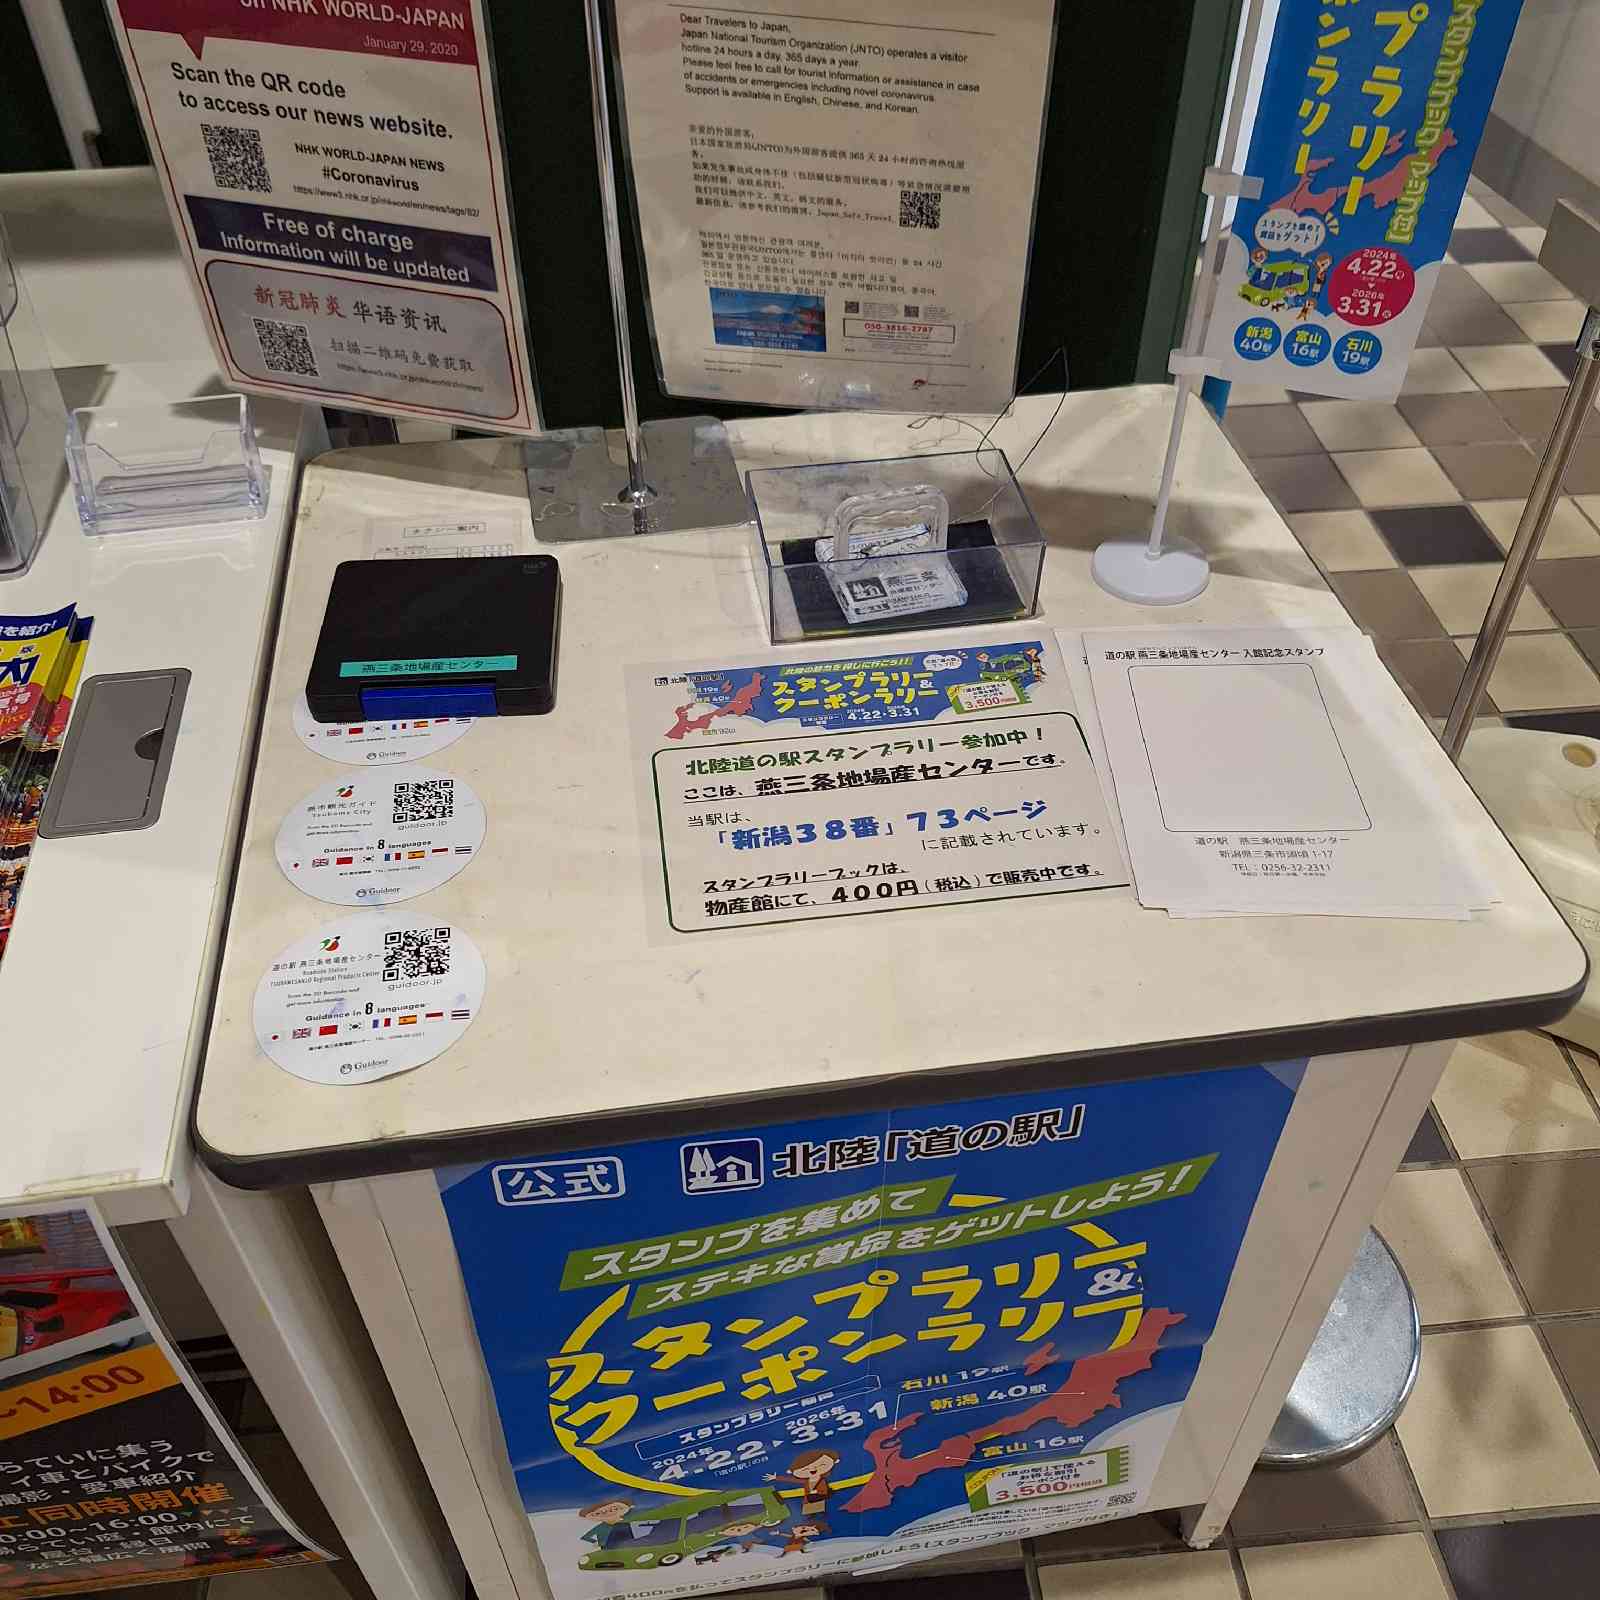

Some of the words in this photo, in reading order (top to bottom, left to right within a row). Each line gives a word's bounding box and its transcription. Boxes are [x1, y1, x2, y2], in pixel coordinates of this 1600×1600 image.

[323, 0, 465, 31] WORLD-JAPAN
[680, 13, 702, 25] Dear
[705, 15, 746, 29] Travelers
[363, 35, 410, 53] January
[431, 43, 459, 57] 2020
[681, 29, 707, 41] Japan
[711, 31, 748, 43] National
[751, 35, 787, 47] Tourism
[789, 38, 848, 53] Organization
[850, 43, 885, 57] (JNTO)
[887, 49, 928, 62] operates
[939, 53, 968, 63] visitor
[681, 42, 711, 54] hotline
[714, 46, 725, 55] 24
[728, 47, 753, 58] hours
[786, 52, 803, 63] 365
[805, 55, 827, 67] days
[171, 61, 220, 85] Scan
[223, 66, 255, 88] the
[261, 71, 293, 93] QR
[298, 75, 347, 98] code
[683, 57, 713, 69] Please
[716, 60, 732, 70] feel
[735, 62, 752, 72] free
[766, 65, 782, 74] call
[784, 67, 795, 75] for
[798, 68, 827, 79] tourist
[828, 70, 880, 84] information
[894, 76, 944, 89] assistance
[957, 83, 980, 92] case
[695, 73, 737, 85] accidents
[751, 78, 808, 92] emergencies
[811, 83, 851, 96] including
[853, 85, 878, 97] novel
[1294, 0, 1351, 176] ンラリー
[685, 83, 720, 97] Support
[732, 89, 771, 101] available
[865, 101, 882, 110] and
[1342, 2, 1430, 217] プラリー
[178, 90, 198, 109] to
[204, 96, 270, 119] access
[276, 104, 308, 123] our
[314, 108, 364, 129] news
[369, 114, 454, 140] website.
[295, 143, 320, 157] NHK
[322, 144, 407, 169] WORLD-JAPAN
[409, 156, 446, 173] NEWS
[321, 166, 420, 193] #Coronavirus
[263, 210, 309, 236] Free
[315, 223, 336, 240] of
[341, 226, 415, 253] charge
[220, 231, 325, 263] Information
[329, 247, 361, 269] will
[367, 252, 389, 273] be
[394, 259, 471, 284] updated
[253, 284, 347, 320] 新冠肺炎
[352, 300, 448, 334] 华语资讯
[1346, 337, 1374, 353] 石川
[0, 619, 57, 637] を紹介!
[1104, 650, 1137, 661] 道の駅
[772, 671, 934, 697] スタンプラリー
[919, 679, 935, 689] &
[774, 687, 940, 714] クーポンラリー
[685, 727, 1044, 776] 北陸道の駅スタンプラリー参加中！
[687, 809, 754, 828] 当駅は、
[377, 839, 385, 850] 8
[920, 822, 1105, 852] に記載されています。
[387, 979, 443, 992] guidoor.jp
[305, 1011, 351, 1022] Guidance
[364, 1002, 374, 1015] 8
[376, 1002, 426, 1014] languages
[354, 1058, 389, 1071] Guidoor
[771, 1103, 1087, 1179] 北陸「道の駅」
[506, 1163, 613, 1200] 公式
[584, 1186, 927, 1282] スタンプを集めて
[1086, 1266, 1136, 1297] &
[546, 1240, 1148, 1402] スタンプラリー
[901, 1374, 949, 1391] 石川
[957, 1363, 1010, 1382] 19駅
[929, 1392, 980, 1412] 新潟
[986, 1382, 1049, 1402] 40駅
[784, 1403, 849, 1432] 2026年
[657, 1440, 768, 1483] 4.22
[791, 1400, 888, 1445] 3.31
[982, 1440, 1028, 1458] 富山
[1034, 1434, 1085, 1450] 16駅
[651, 1445, 715, 1470] 2024年
